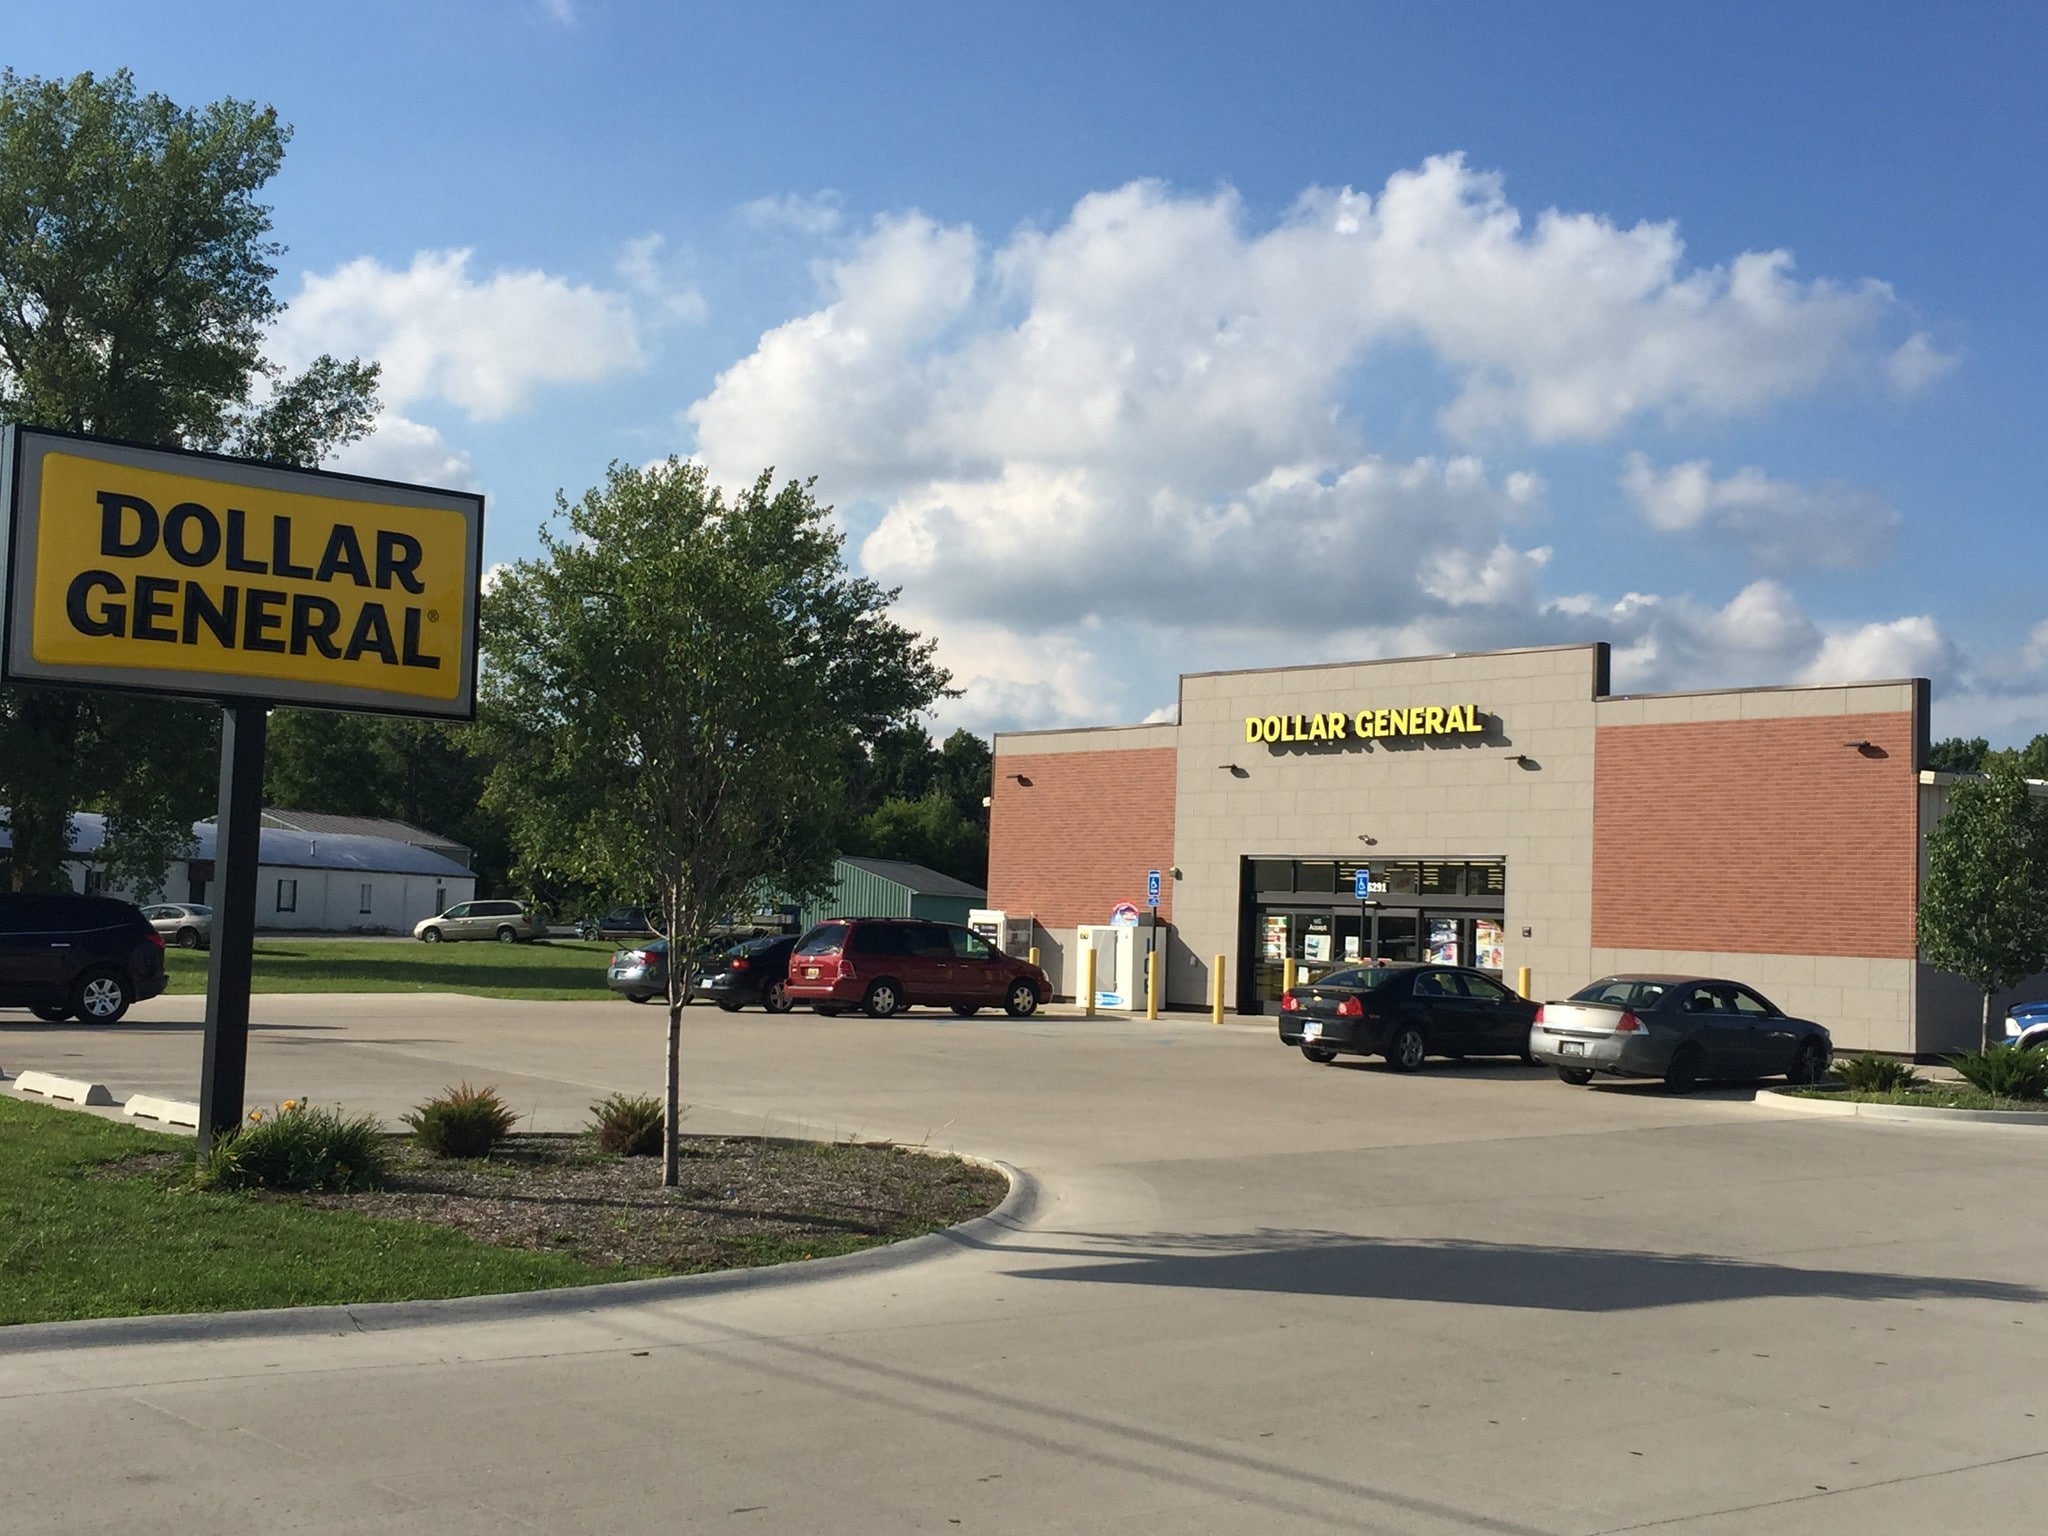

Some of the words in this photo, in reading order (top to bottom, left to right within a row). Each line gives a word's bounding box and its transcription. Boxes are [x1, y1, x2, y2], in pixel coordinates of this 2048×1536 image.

[96, 490, 425, 594] DOLLAR
[66, 569, 441, 670] GENERAL
[1245, 712, 1346, 743] DOLLAR
[1355, 704, 1482, 738] GENERAL
